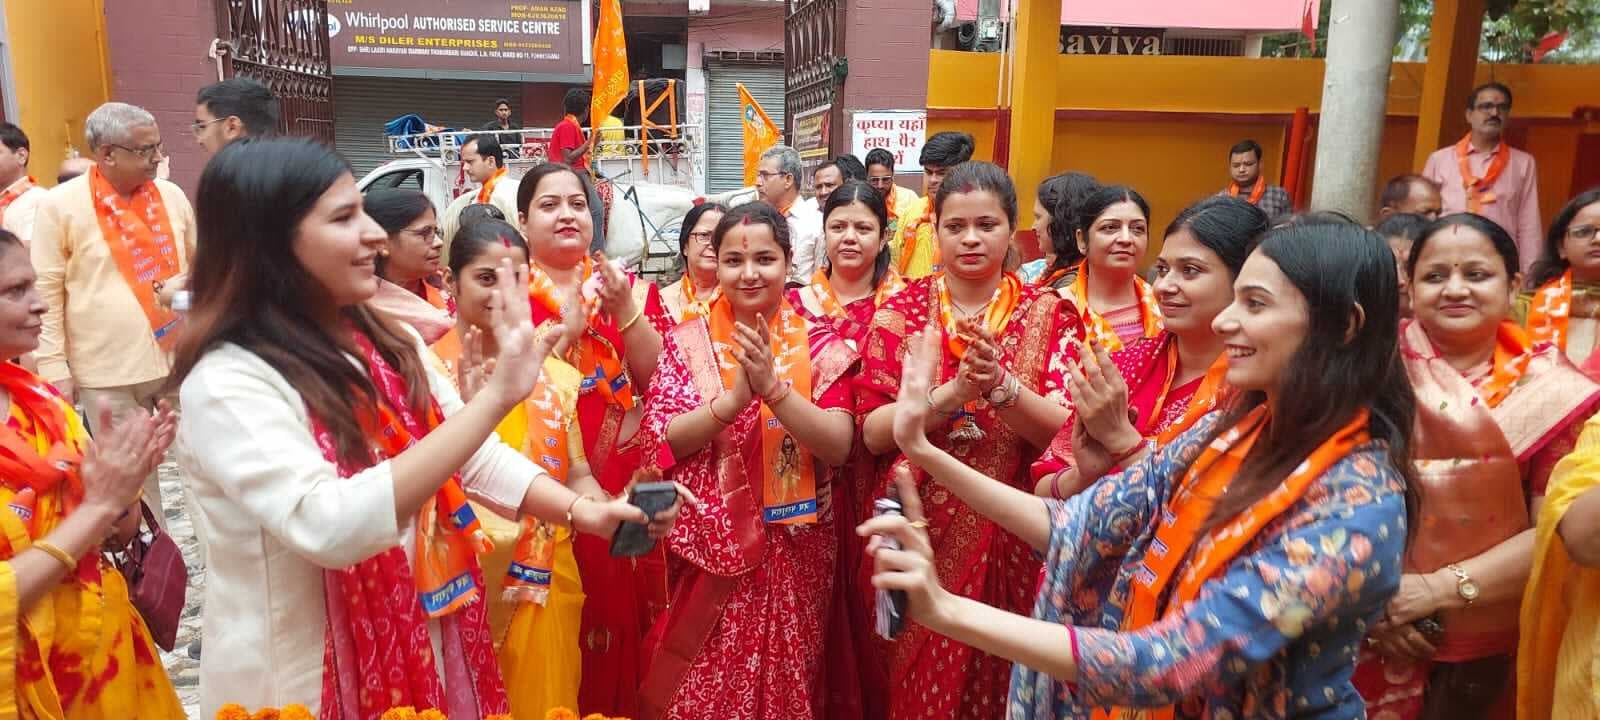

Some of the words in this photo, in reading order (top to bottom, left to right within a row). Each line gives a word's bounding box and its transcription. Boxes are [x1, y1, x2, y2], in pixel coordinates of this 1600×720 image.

[345, 11, 409, 34] Whirlpool
[413, 16, 476, 32] AUTHORISED
[478, 19, 520, 33] SERVICE
[522, 21, 560, 35] CENTRE
[355, 35, 376, 45] M/S
[379, 36, 415, 46] DILER
[417, 37, 498, 49] ENTERPRISES
[899, 113, 927, 131] यहाँ
